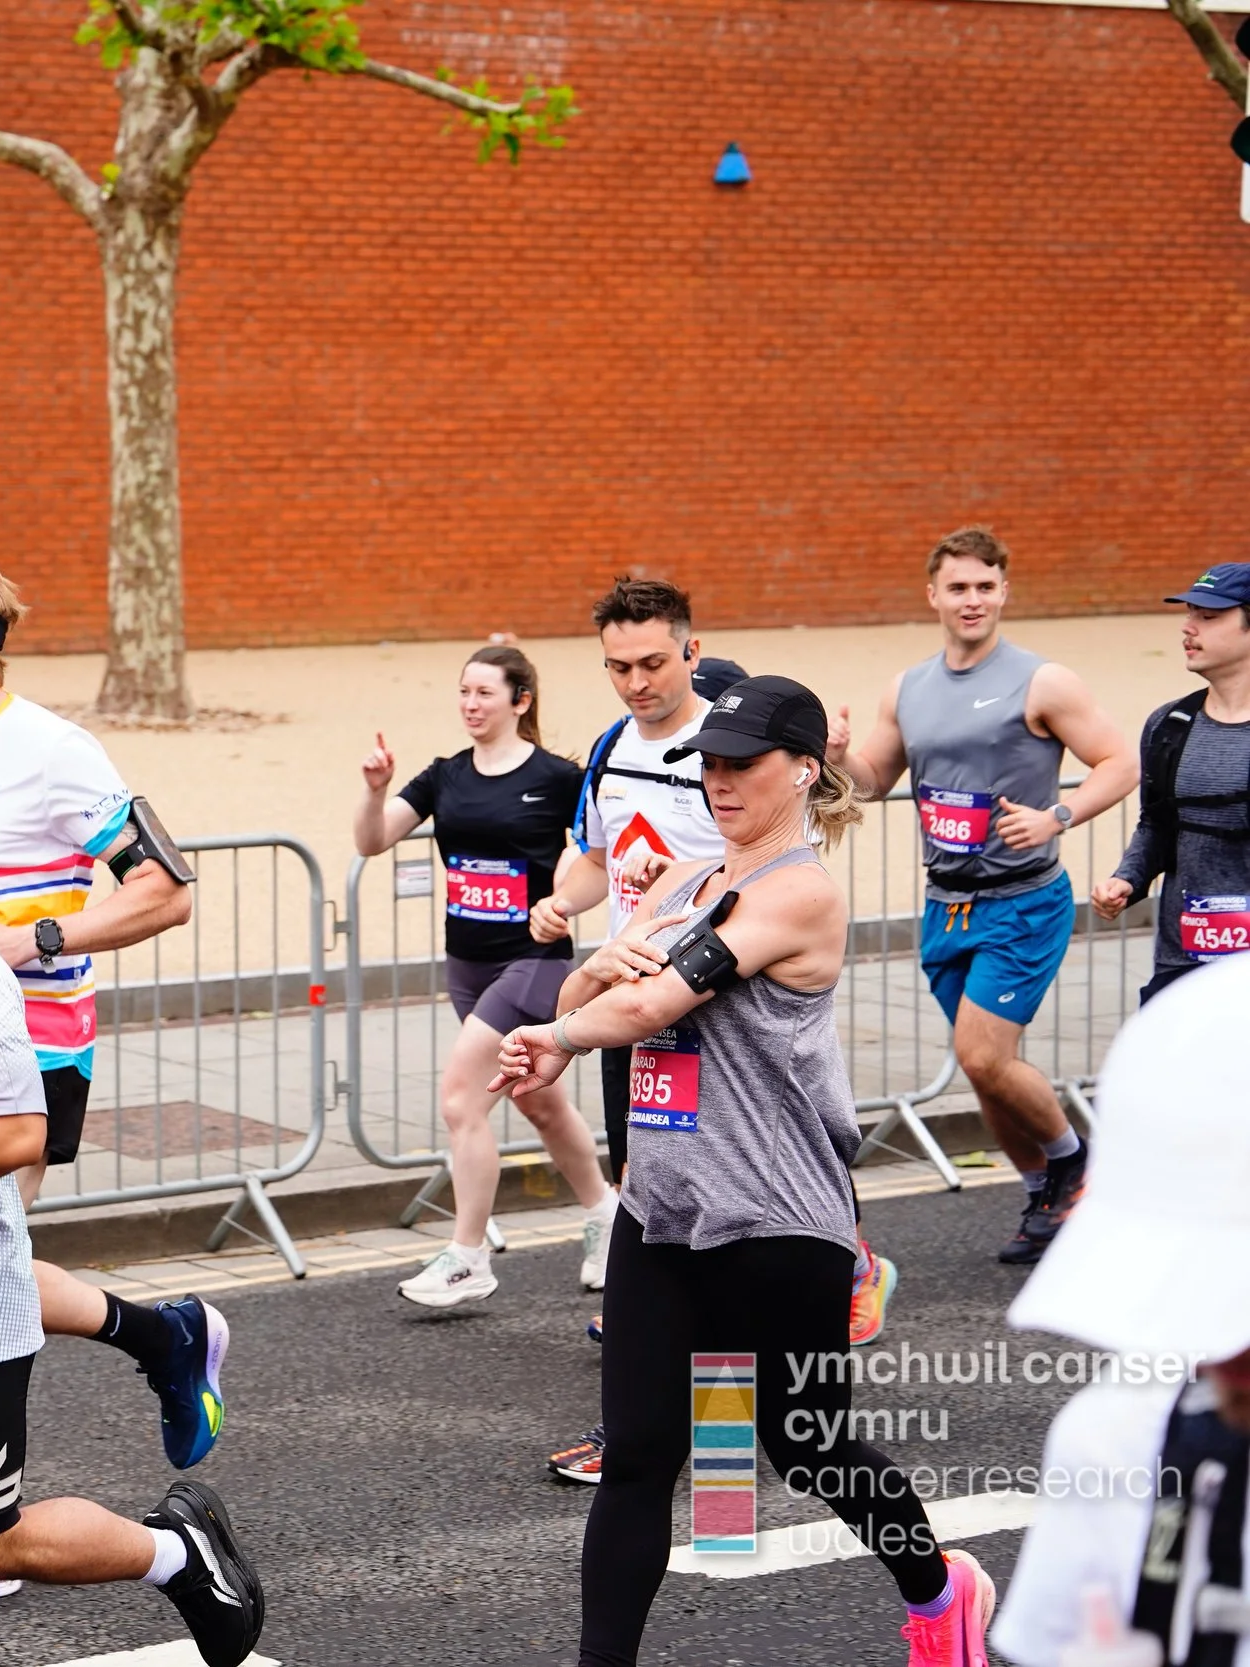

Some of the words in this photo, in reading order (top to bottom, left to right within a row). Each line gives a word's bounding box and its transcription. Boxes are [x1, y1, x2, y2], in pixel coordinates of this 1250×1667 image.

[929, 815, 971, 840] 2486
[459, 885, 510, 908] 2813
[1193, 927, 1250, 949] 4542
